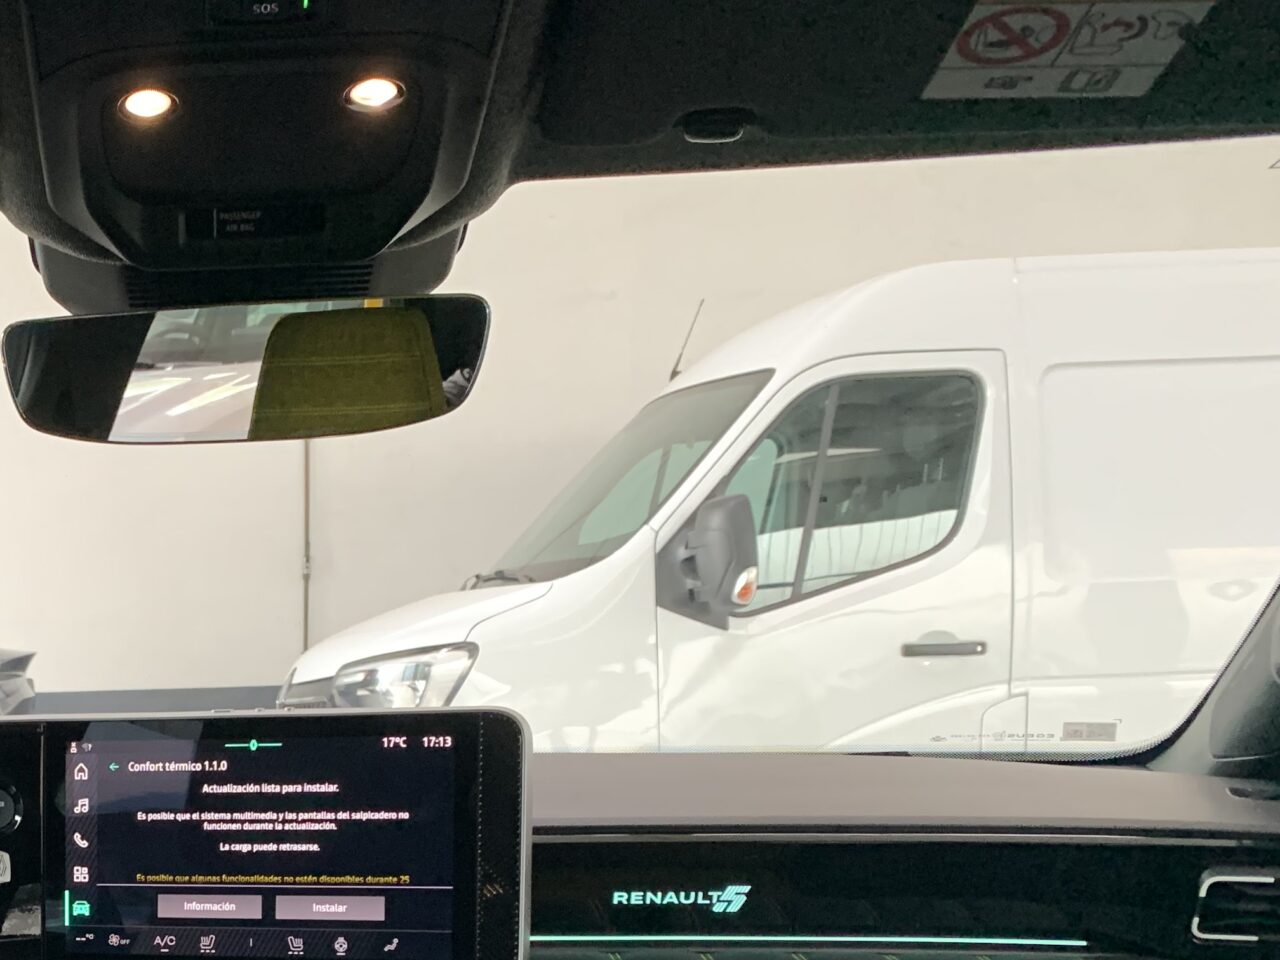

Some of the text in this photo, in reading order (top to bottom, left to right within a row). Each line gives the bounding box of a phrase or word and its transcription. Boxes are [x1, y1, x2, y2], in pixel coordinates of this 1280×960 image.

[253, 3, 279, 14] SOS
[422, 736, 452, 748] 17:13
[128, 760, 228, 771] Confort térmico 1.1.0
[202, 783, 339, 794] Actualización lista para instalar.
[137, 812, 146, 820] Es
[147, 811, 175, 822] posible
[176, 813, 191, 822] que
[192, 811, 200, 820] el
[201, 811, 232, 820] sistema
[233, 811, 277, 820] multimedia
[278, 812, 284, 821] y
[285, 811, 297, 820] las
[298, 811, 336, 821] pantallas
[337, 811, 350, 820] del
[351, 811, 398, 821] salpicadero
[203, 821, 337, 831] funcionen durante la actualización.
[220, 842, 321, 853] La carga puede retrasarse.
[136, 874, 145, 882] Es
[147, 874, 174, 883] posible
[222, 875, 281, 884] funcionalidades
[283, 876, 294, 884] no
[319, 875, 364, 884] disponibles
[365, 876, 398, 884] durante
[612, 891, 721, 905] RENAULT
[184, 901, 236, 911] Información
[312, 903, 348, 913] Instalar
[153, 935, 176, 946] A/C
